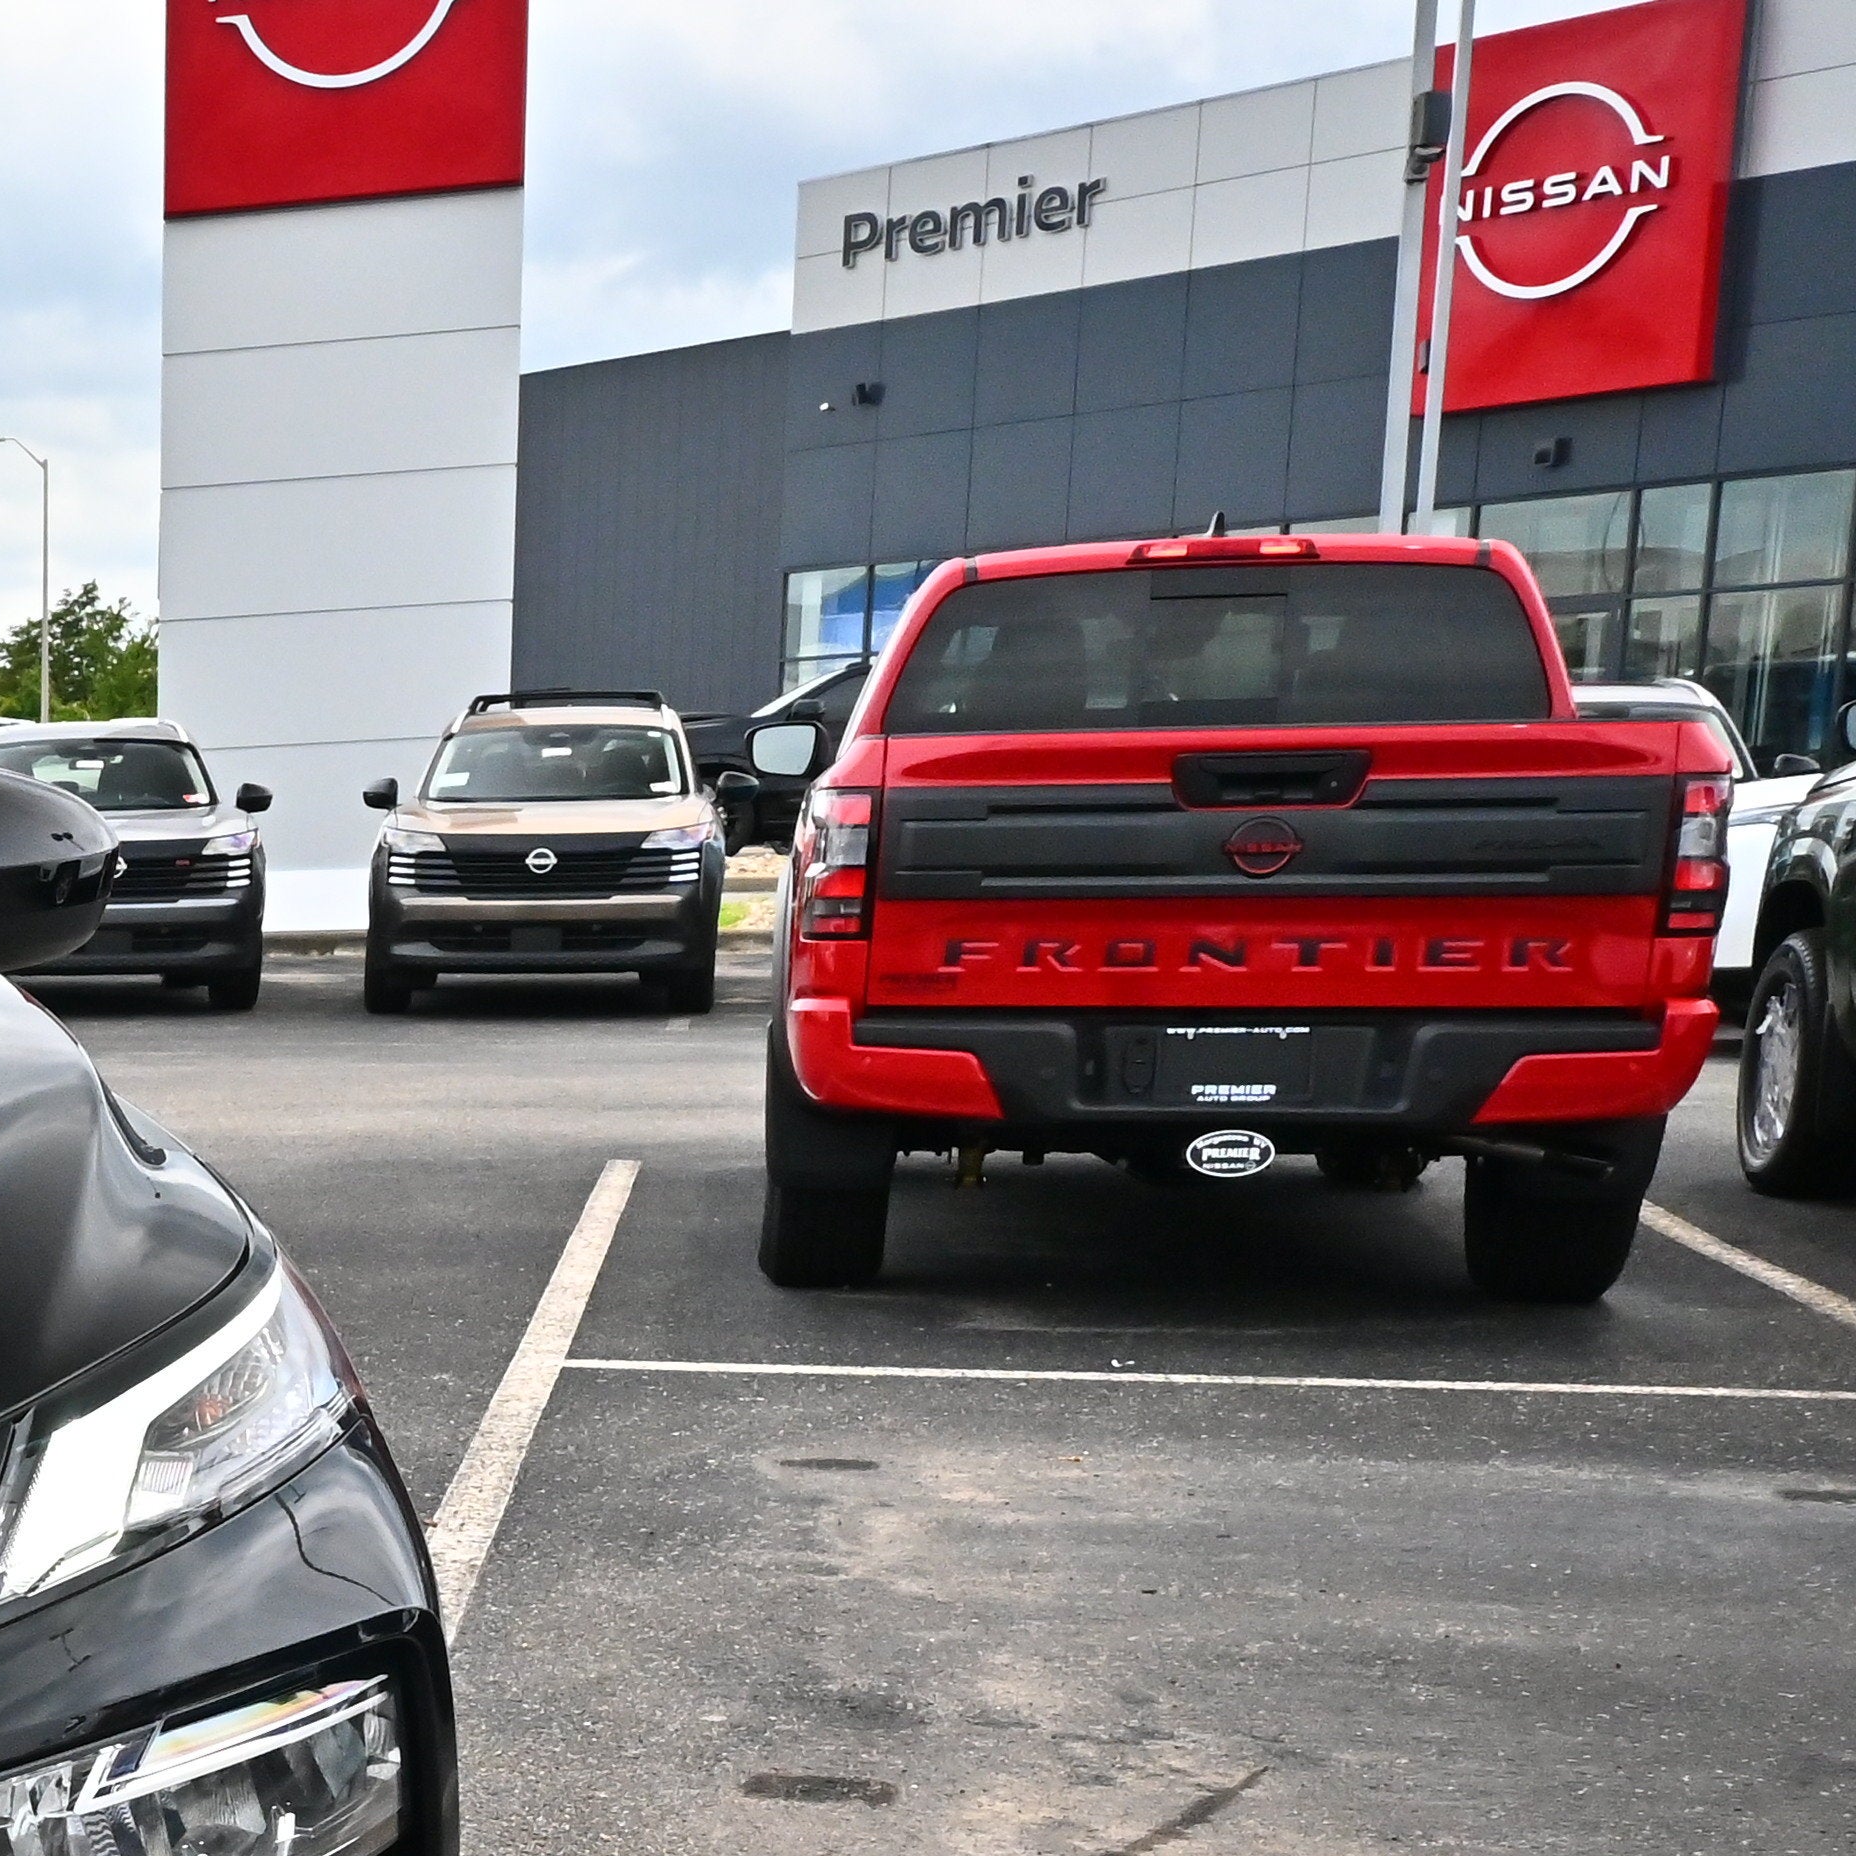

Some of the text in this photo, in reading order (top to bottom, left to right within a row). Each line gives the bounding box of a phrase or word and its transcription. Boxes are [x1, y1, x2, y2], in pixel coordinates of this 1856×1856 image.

[842, 174, 1107, 269] Premier
[938, 938, 1575, 972] FRONTIER
[1190, 1084, 1278, 1095] PREMIER
[1201, 1147, 1261, 1161] PREMIER
